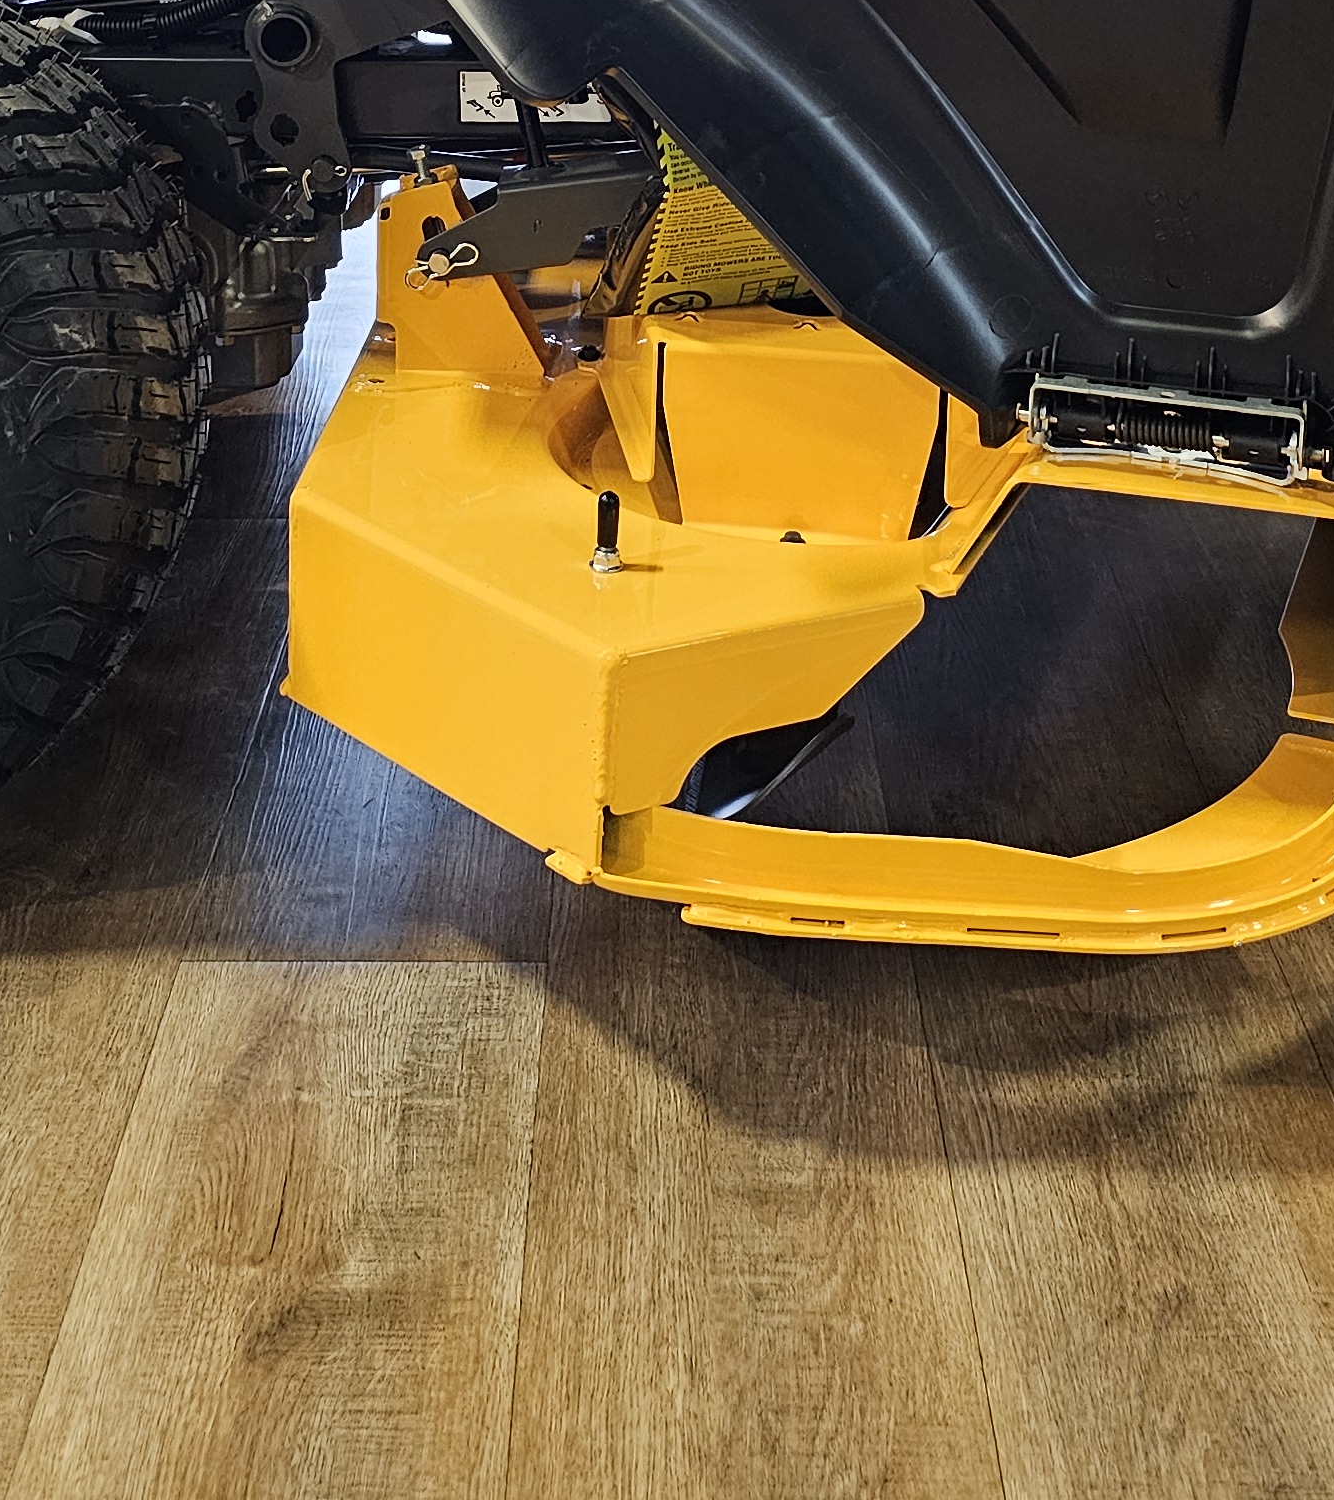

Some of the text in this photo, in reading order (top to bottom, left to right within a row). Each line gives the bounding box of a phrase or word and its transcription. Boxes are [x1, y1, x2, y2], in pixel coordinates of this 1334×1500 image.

[673, 185, 694, 194] Know
[693, 204, 710, 212] Give
[680, 223, 713, 233] Extreme
[684, 262, 712, 271] RIDING
[713, 257, 749, 267] MOWERS
[750, 255, 766, 263] ARE
[682, 267, 721, 277] NOT TOYS
